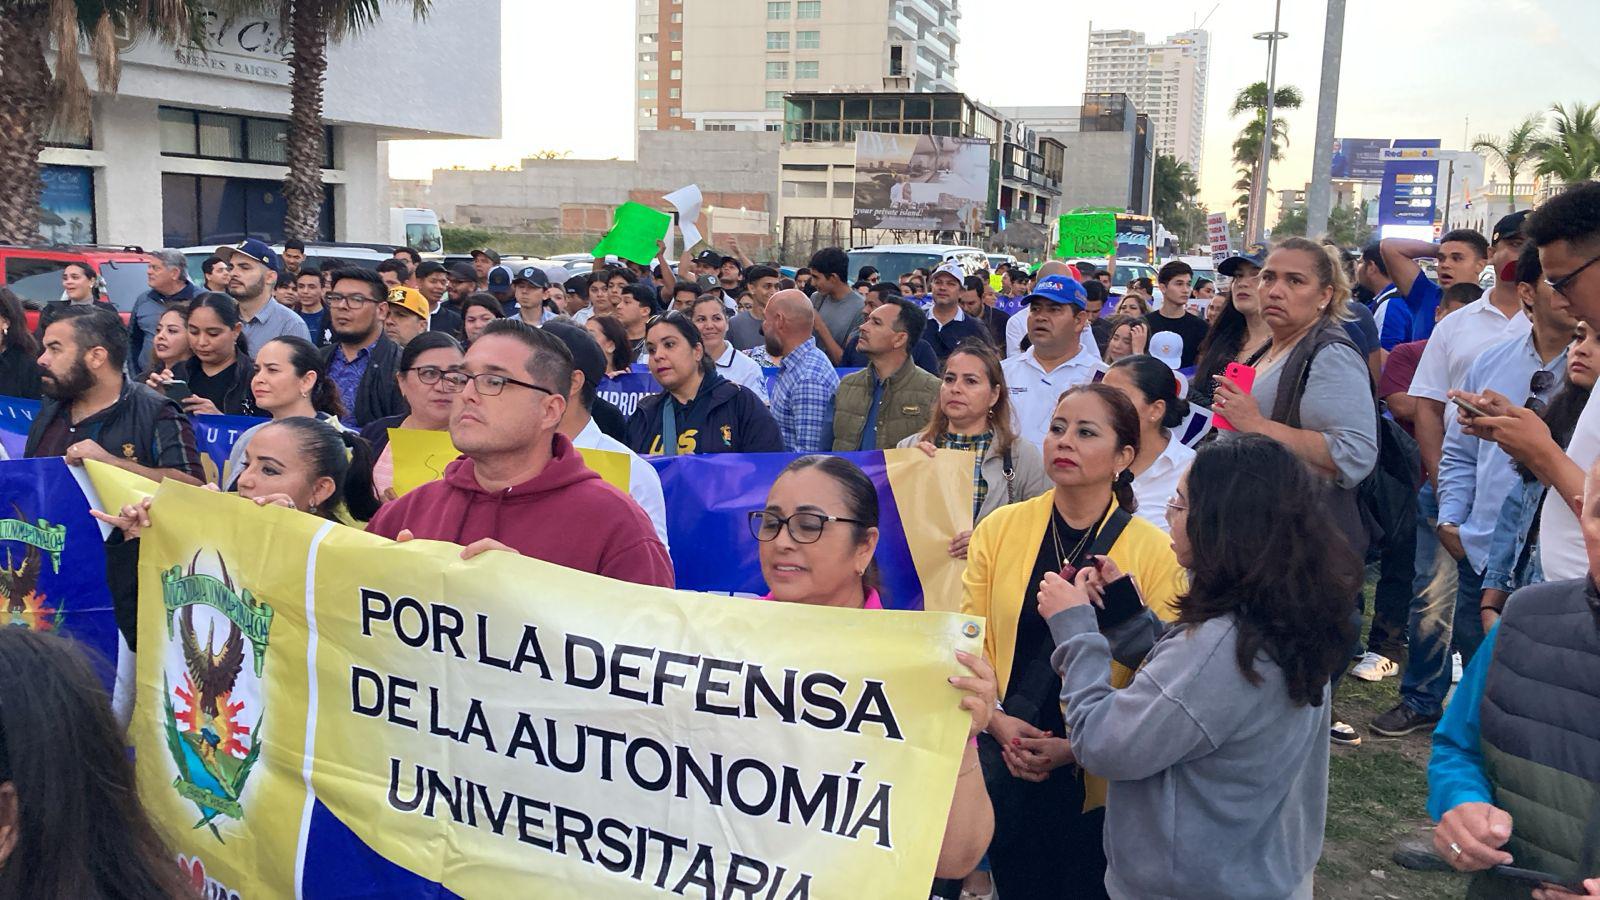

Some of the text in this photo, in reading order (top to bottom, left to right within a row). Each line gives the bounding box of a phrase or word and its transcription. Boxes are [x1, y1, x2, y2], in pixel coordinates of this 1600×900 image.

[360, 588, 906, 741] POR LA DEFENSA
[351, 666, 894, 850] DE LA AUTONOMÍA
[388, 757, 813, 900] UNIVERSITARIA
